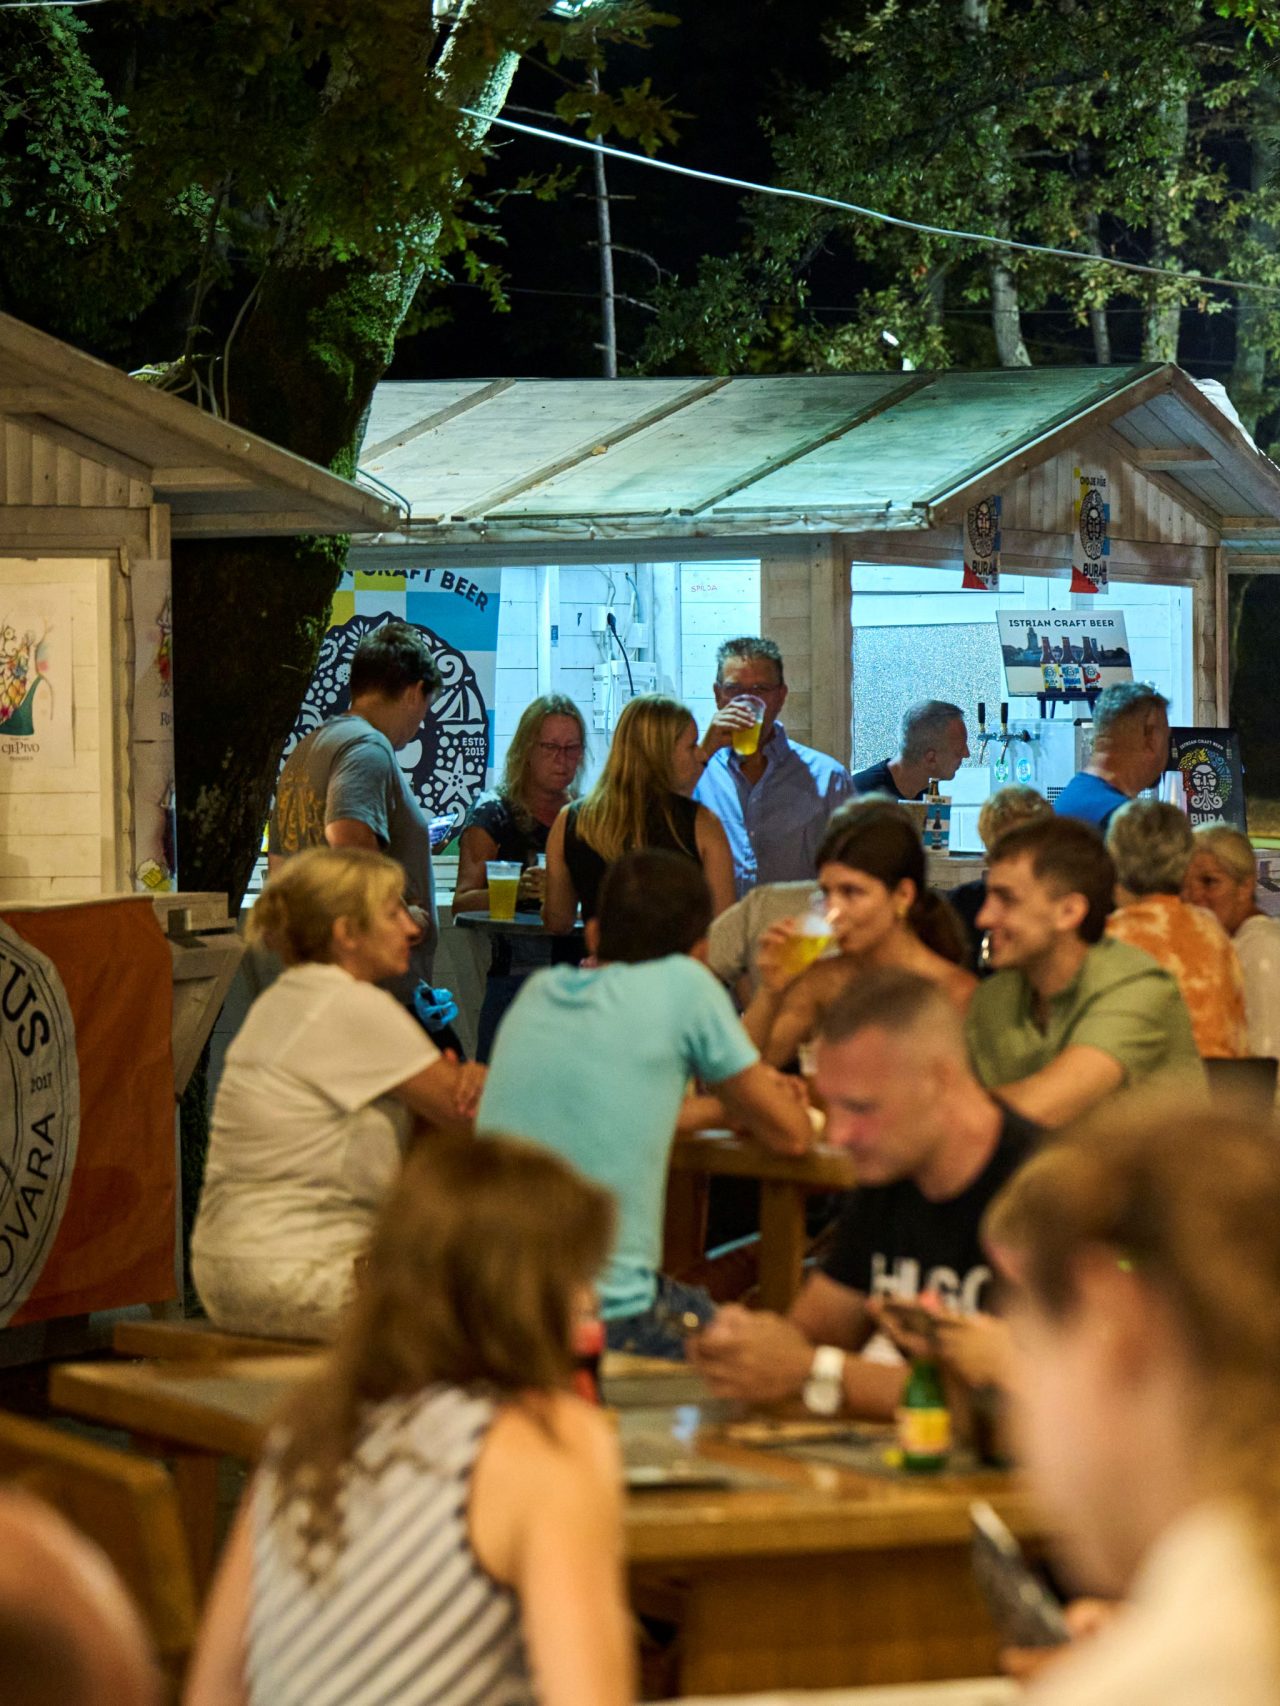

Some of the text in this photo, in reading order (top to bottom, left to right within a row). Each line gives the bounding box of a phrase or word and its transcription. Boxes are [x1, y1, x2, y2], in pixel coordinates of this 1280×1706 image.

[440, 570, 488, 612] BEER
[1009, 619, 1115, 627] ISTRIAN CRAFT BEER
[462, 737, 487, 746] ESTD.
[465, 747, 485, 756] 2015
[1190, 813, 1226, 825] BURA
[0, 955, 51, 1058] US
[30, 1071, 53, 1094] 2017
